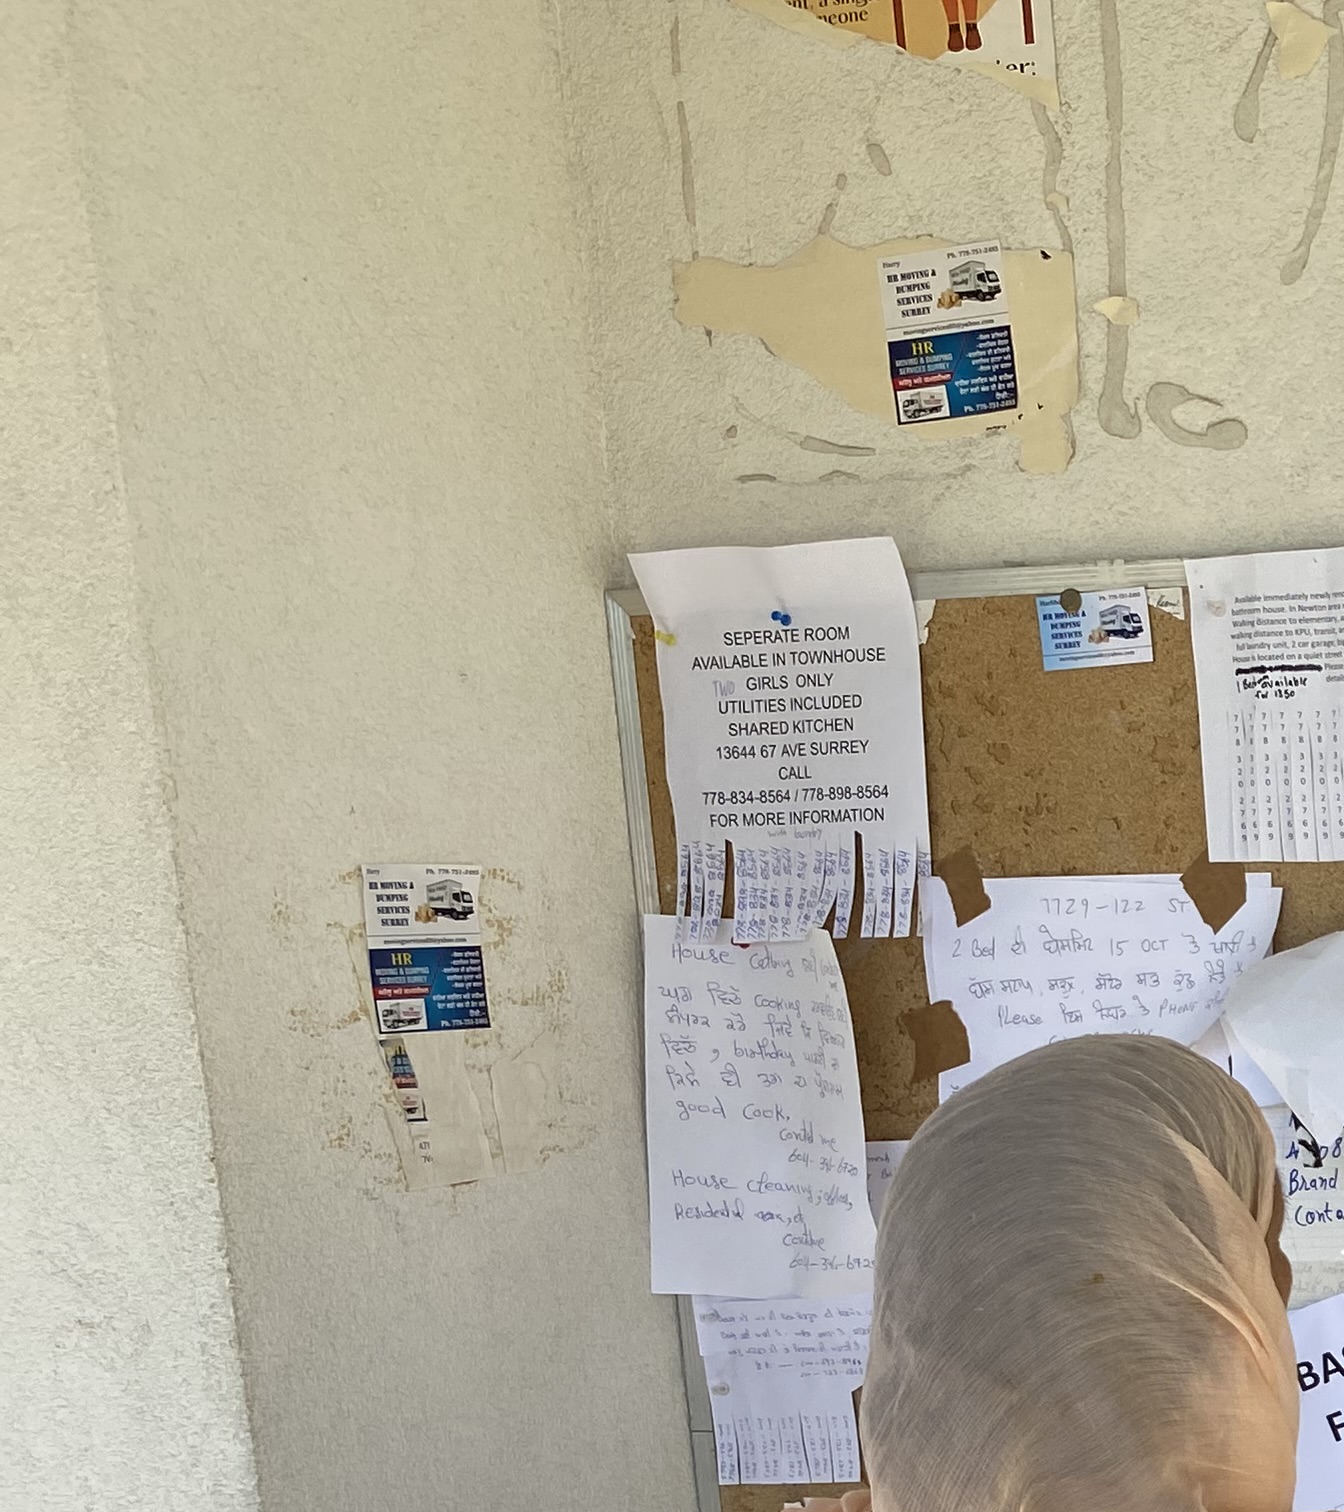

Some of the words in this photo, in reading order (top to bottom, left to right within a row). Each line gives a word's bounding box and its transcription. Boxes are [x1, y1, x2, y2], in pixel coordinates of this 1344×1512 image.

[901, 270, 929, 282] MOVING
[897, 294, 933, 306] SERVICES
[901, 307, 931, 318] SURREY
[911, 341, 934, 355] HR
[724, 629, 800, 646] SEPERATE
[804, 626, 850, 642] ROOM
[692, 654, 768, 670] AVAILABLE
[773, 653, 785, 667] IN
[790, 648, 886, 665] TOWNHOUSE
[746, 676, 788, 691] GIRLS
[796, 673, 834, 688] ONLY
[719, 699, 786, 714] UTILITIES
[790, 694, 862, 711] INCLUDED
[729, 721, 789, 736] SHARED
[793, 718, 853, 733] KITCHEN
[716, 745, 756, 759] 13644
[760, 745, 776, 758] 67
[781, 743, 806, 757] AVE
[810, 740, 869, 756] SURREY
[778, 766, 812, 780] CALL
[702, 790, 790, 805] 778-834-8564
[802, 785, 888, 801] 778-898-8564
[710, 814, 738, 828] FOR
[743, 812, 785, 826] MORE
[790, 808, 884, 825] INFORMATION
[391, 953, 412, 965] HR
[1289, 1168, 1339, 1195] Brand
